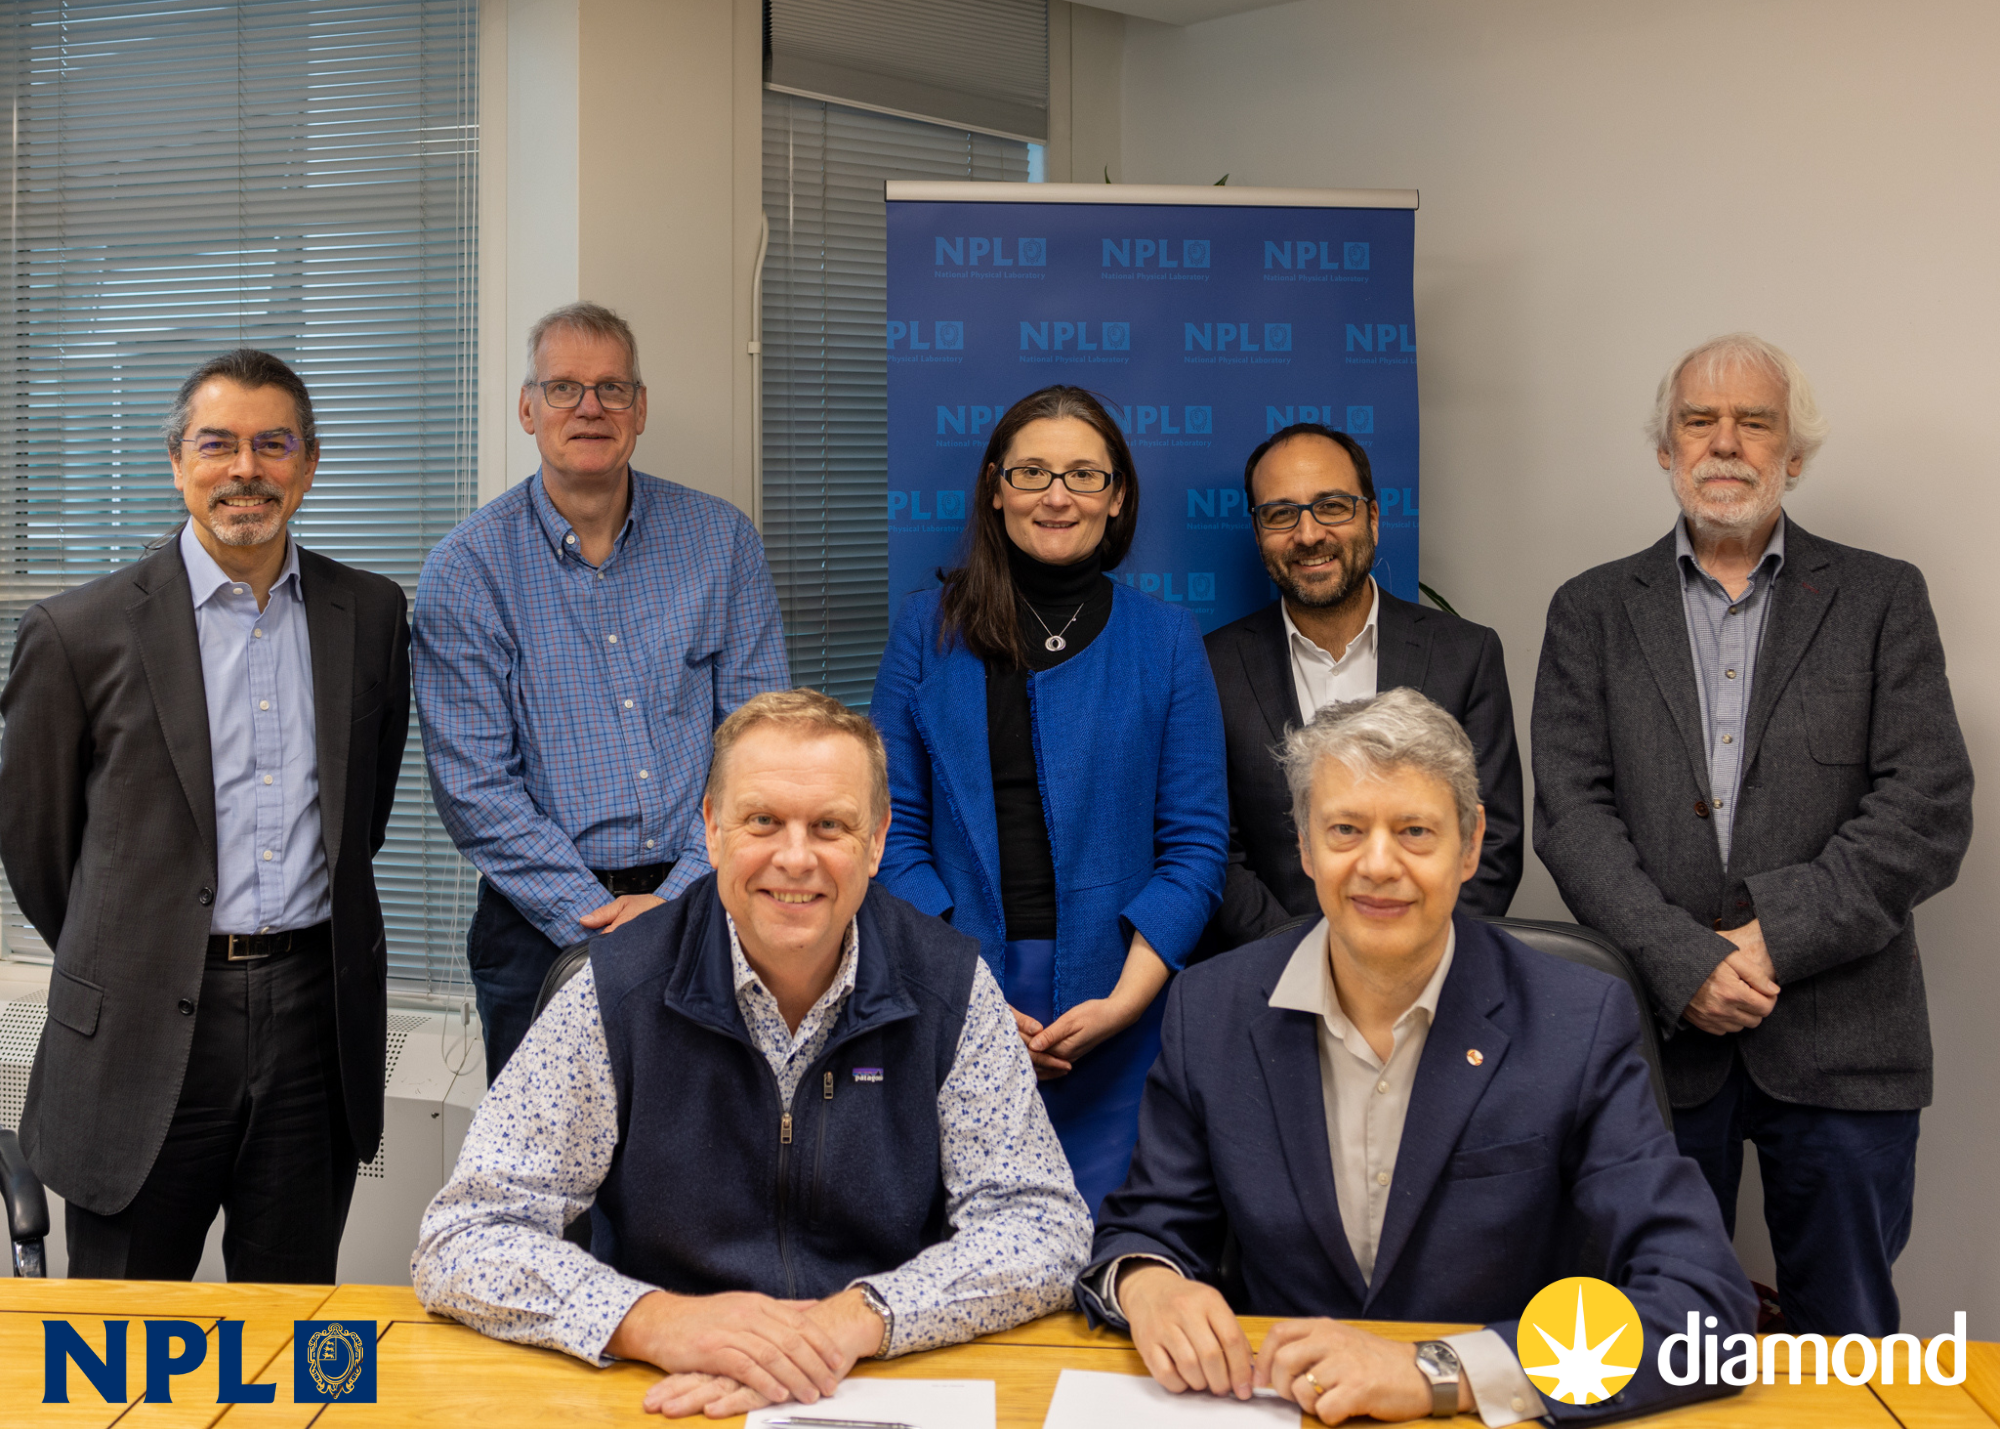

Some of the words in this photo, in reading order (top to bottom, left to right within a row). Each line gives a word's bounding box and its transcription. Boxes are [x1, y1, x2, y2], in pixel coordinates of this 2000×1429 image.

[935, 236, 1013, 267] NPL
[1101, 238, 1178, 268] NPL
[1264, 240, 1339, 270] NPL
[970, 271, 1001, 280] Physical
[1004, 271, 1046, 280] Laboratory
[1136, 272, 1167, 281] Physical
[1169, 273, 1209, 281] Laboratory
[1298, 274, 1328, 282] Physical
[1330, 275, 1369, 283] Laboratory
[1020, 321, 1098, 350] NPL
[1184, 322, 1260, 351] NPL
[1345, 323, 1417, 352] NPL
[887, 354, 918, 363] Physical
[920, 355, 963, 363] Laboratory
[1055, 355, 1086, 364] Physical
[1088, 356, 1130, 364] Laboratory
[1218, 356, 1248, 365] Physical
[1250, 357, 1291, 365] Laboratory
[1379, 357, 1408, 365] Physical
[1139, 440, 1169, 448] Physical
[1171, 440, 1212, 448] Laboratory
[888, 525, 919, 534] Physical
[922, 525, 965, 534] Laboratory
[1221, 523, 1251, 531] Physical
[1381, 521, 1411, 530] Physical
